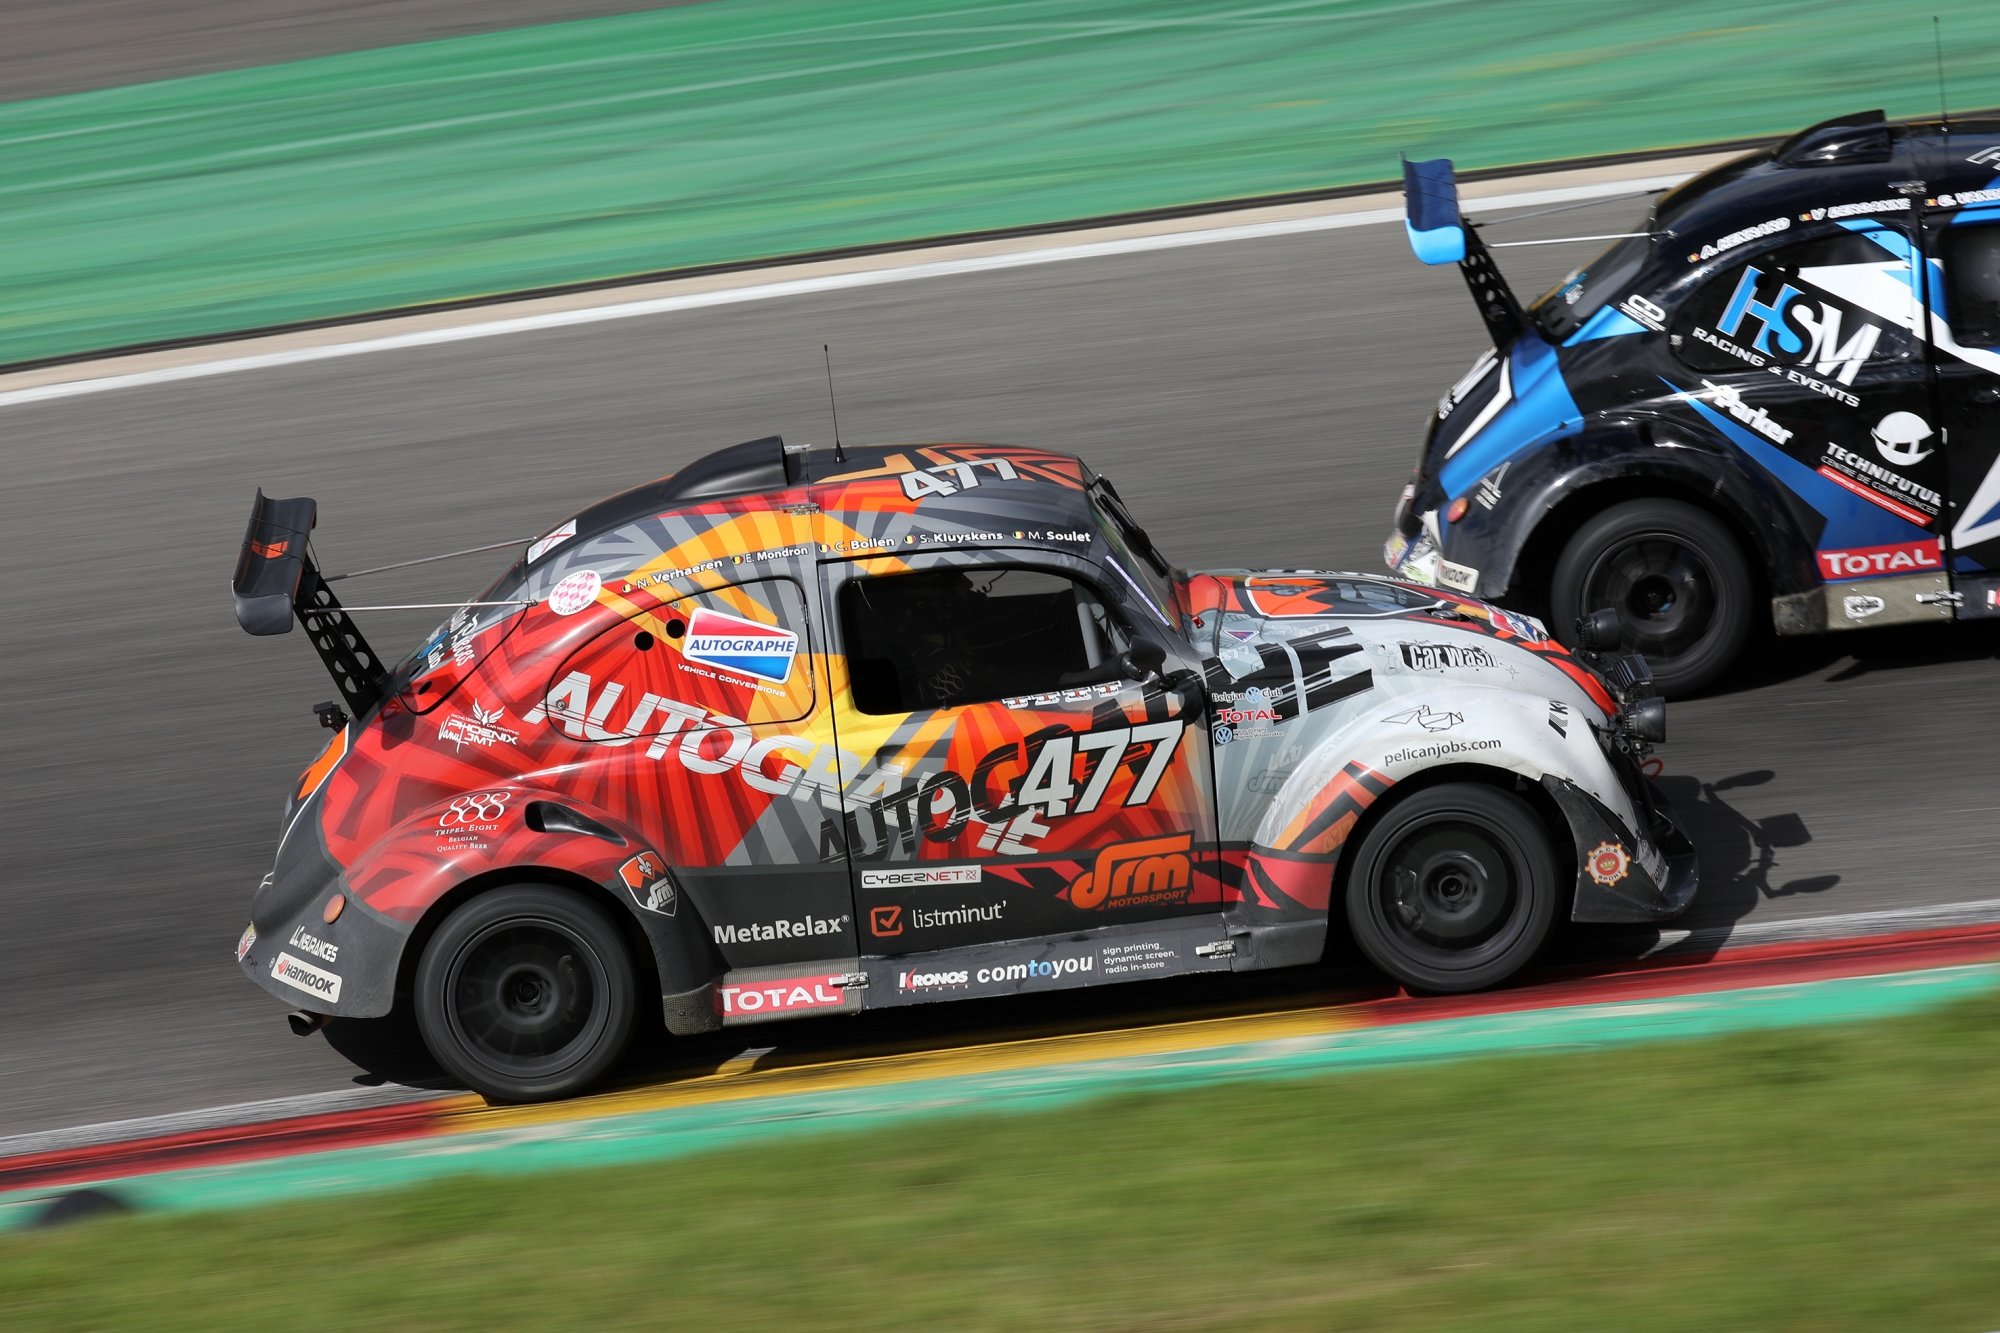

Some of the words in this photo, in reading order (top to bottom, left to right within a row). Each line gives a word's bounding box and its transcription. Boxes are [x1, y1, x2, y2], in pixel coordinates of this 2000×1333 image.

[1715, 265, 1882, 387] HSM
[1692, 327, 1766, 367] RACING
[1768, 365, 1783, 376] &
[1787, 370, 1860, 408] EVENTS
[1713, 384, 1794, 446] Parker
[900, 457, 1019, 501] 477
[1820, 455, 1857, 478] CENTRE
[1857, 473, 1872, 484] DE
[834, 541, 848, 551] C.
[850, 536, 895, 551] Bollen
[919, 535, 932, 544] S.
[933, 531, 1004, 544] Kluyskens
[1028, 531, 1044, 541] M.
[1046, 530, 1092, 542] Soulet
[745, 554, 755, 564] E.
[756, 546, 808, 562] Mondron
[1821, 548, 1937, 575] TOTAL
[636, 578, 650, 590] N.
[652, 559, 723, 584] Verhaeren
[689, 639, 795, 652] AUTOGRAPHE
[1408, 645, 1442, 672] Car
[1443, 646, 1499, 668] Wash
[677, 663, 716, 679] VEHICLE
[718, 674, 787, 698] CONVERSIONS
[1212, 690, 1246, 703] Belgian
[1261, 687, 1283, 698] Club
[1216, 708, 1282, 723] TOTAL
[447, 719, 518, 746] PHOENIX
[464, 733, 497, 747] JMT
[1384, 739, 1502, 767] pelicanjobs.com
[1017, 719, 1184, 818] 477
[439, 791, 511, 827] 888
[435, 826, 465, 837] TRIPEL
[467, 824, 499, 832] EIGHT
[448, 835, 479, 843] BELGIAN
[436, 843, 467, 853] QUALITY
[469, 842, 488, 850] BEER
[863, 870, 964, 885] CYBERNET
[1597, 870, 1623, 881] SPORT
[1107, 889, 1187, 909] MOTORSPORT
[1102, 946, 1122, 956] sign
[1104, 953, 1143, 966] dynamic
[899, 967, 968, 988] KRONOS
[976, 956, 1093, 983] comtoyou
[1105, 965, 1128, 974] radio
[716, 983, 838, 1012] TOTAL
[899, 984, 969, 995] EVENTS
